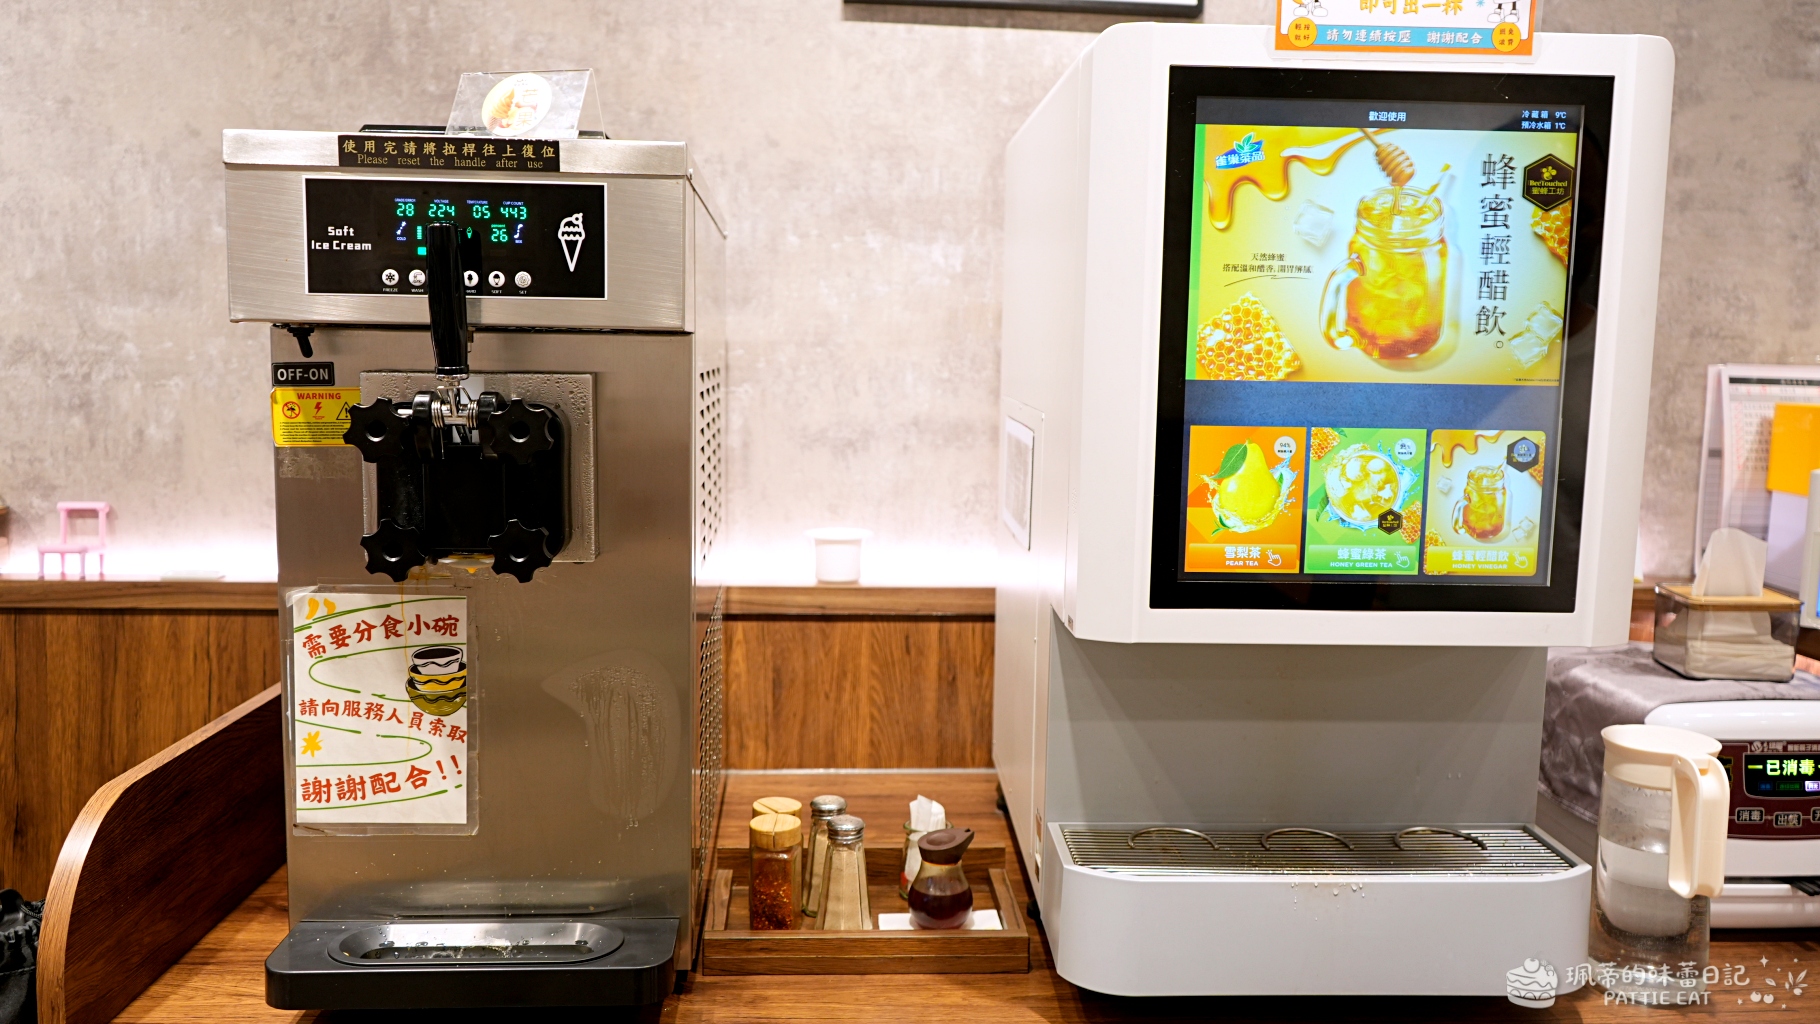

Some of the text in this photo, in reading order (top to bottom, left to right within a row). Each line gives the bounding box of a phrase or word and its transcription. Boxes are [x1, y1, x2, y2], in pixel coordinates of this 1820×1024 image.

[1326, 29, 1484, 45] 請勿連續按壓 謝謝配合
[1368, 111, 1407, 122] 歡迎使用
[1521, 110, 1549, 119] 冷藏箱
[1521, 121, 1552, 130] 預冷水箱
[342, 139, 556, 159] 使用完請將拉桿往上復位
[357, 154, 544, 168] Please reset the handle after use
[1532, 187, 1565, 195] 蜜蜂工坊
[396, 203, 415, 217] 28
[428, 203, 455, 217] 224
[472, 204, 491, 219] 05
[500, 206, 527, 220] 443
[327, 226, 355, 236] Soft
[490, 228, 509, 242] 26
[311, 240, 372, 251] Ice Cream
[1251, 252, 1285, 262] 天然蜂蜜
[277, 368, 329, 381] OFF-ON
[296, 392, 342, 400] WARNING
[1224, 546, 1261, 560] 雪梨茶
[1337, 547, 1387, 561] 蜂蜜綠茶
[1452, 549, 1509, 563] 蜂蜜輕醋飲
[302, 614, 460, 659] 需要分食小碗
[298, 699, 467, 743] 請向服務人員索取
